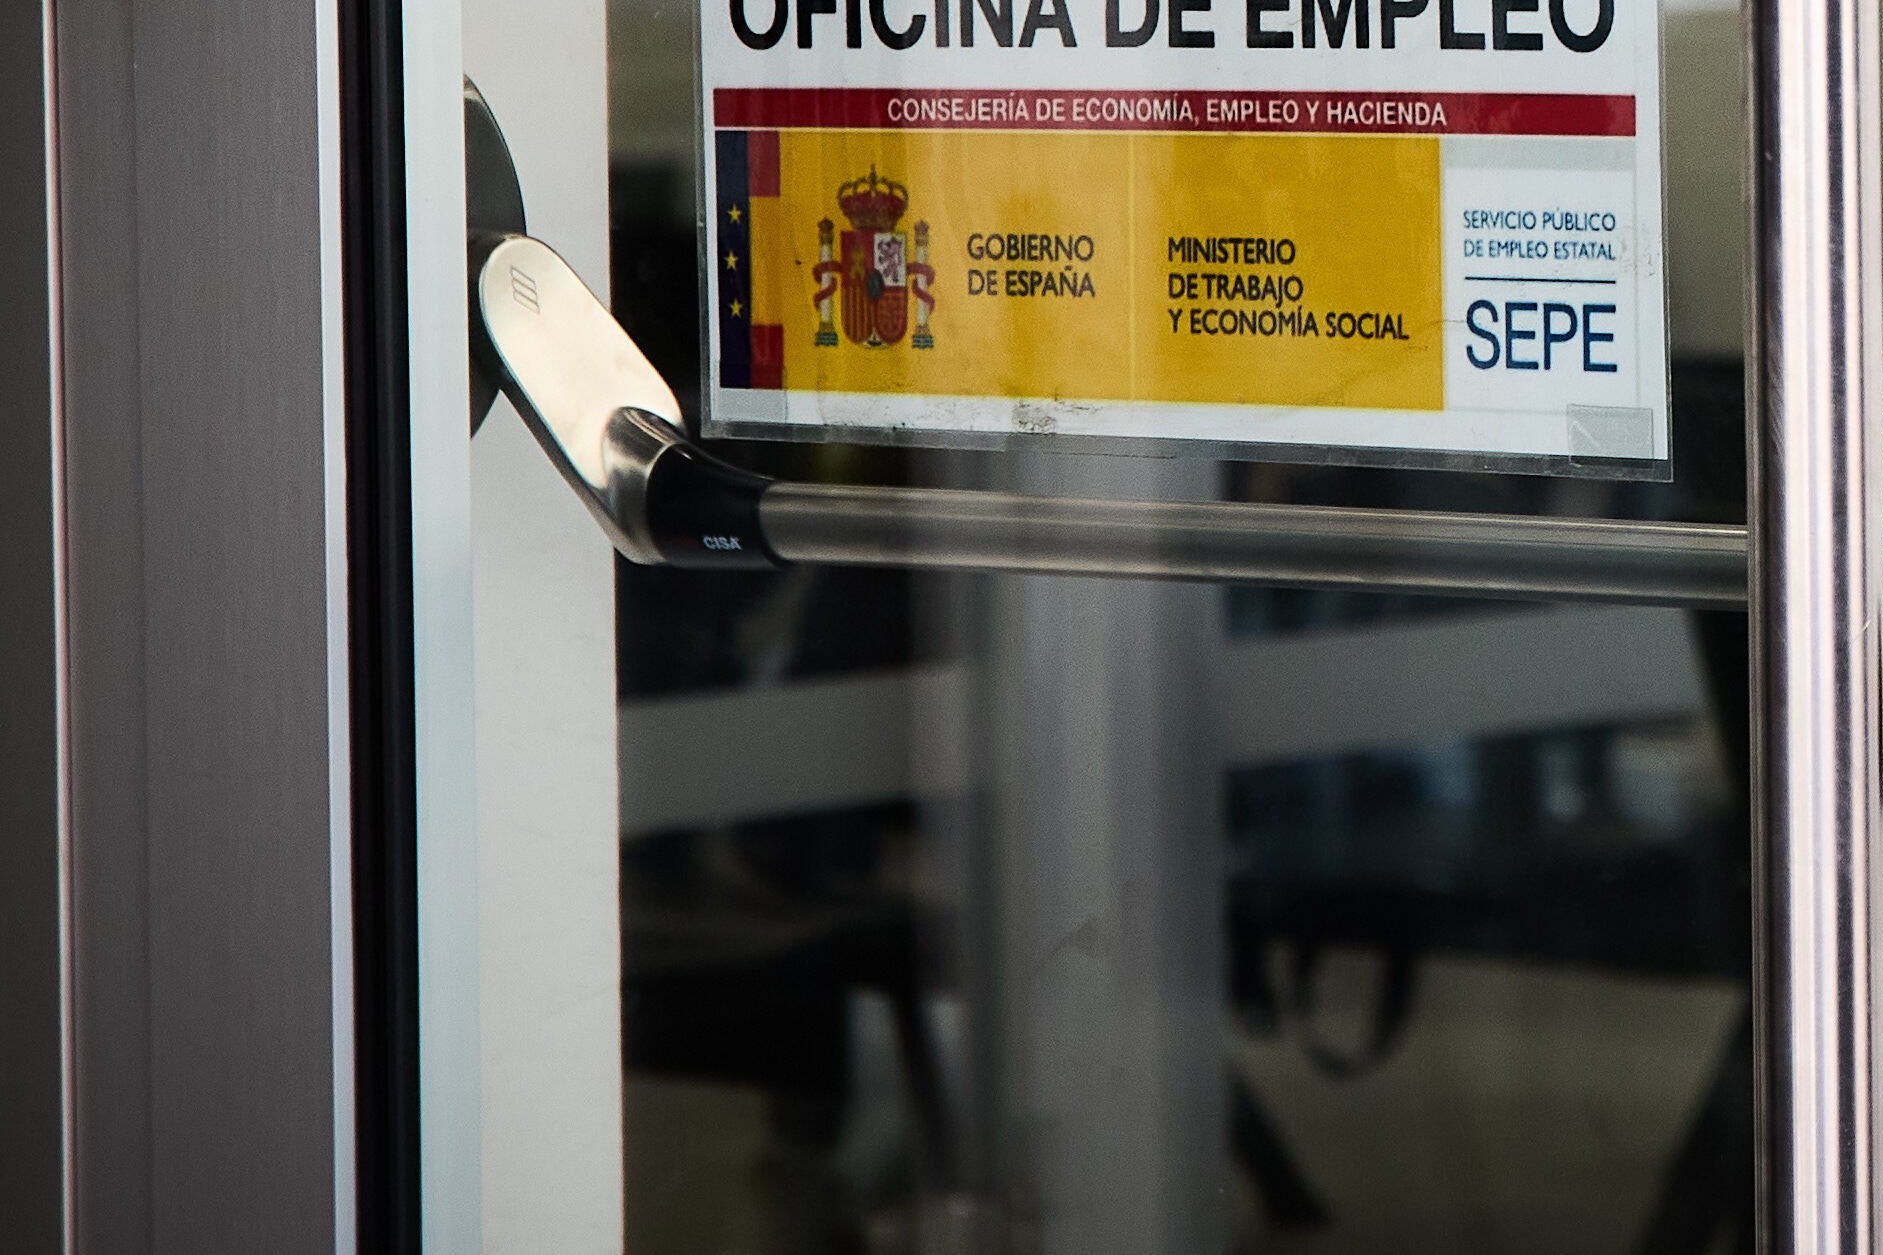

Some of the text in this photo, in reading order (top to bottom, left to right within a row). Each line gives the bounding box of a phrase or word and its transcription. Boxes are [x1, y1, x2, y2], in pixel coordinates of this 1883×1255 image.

[887, 91, 1447, 126] CONSEJERÍA DE ECONOMÍA, EMPLEO Y HACIENDA
[1463, 207, 1617, 232] SERVICIO PÚBLICO
[966, 233, 1095, 262] GOBIERNO
[1167, 236, 1296, 265] MINISTERIO
[1463, 239, 1617, 261] DE EMPLEO ESTATAL
[967, 265, 1096, 298] DE ESPAÑA
[1168, 273, 1304, 308] DE TRABAJO
[1167, 304, 1410, 340] Y ECONOMÍA SOCIAL
[1465, 299, 1618, 373] SEPE
[702, 535, 742, 551] CISA
